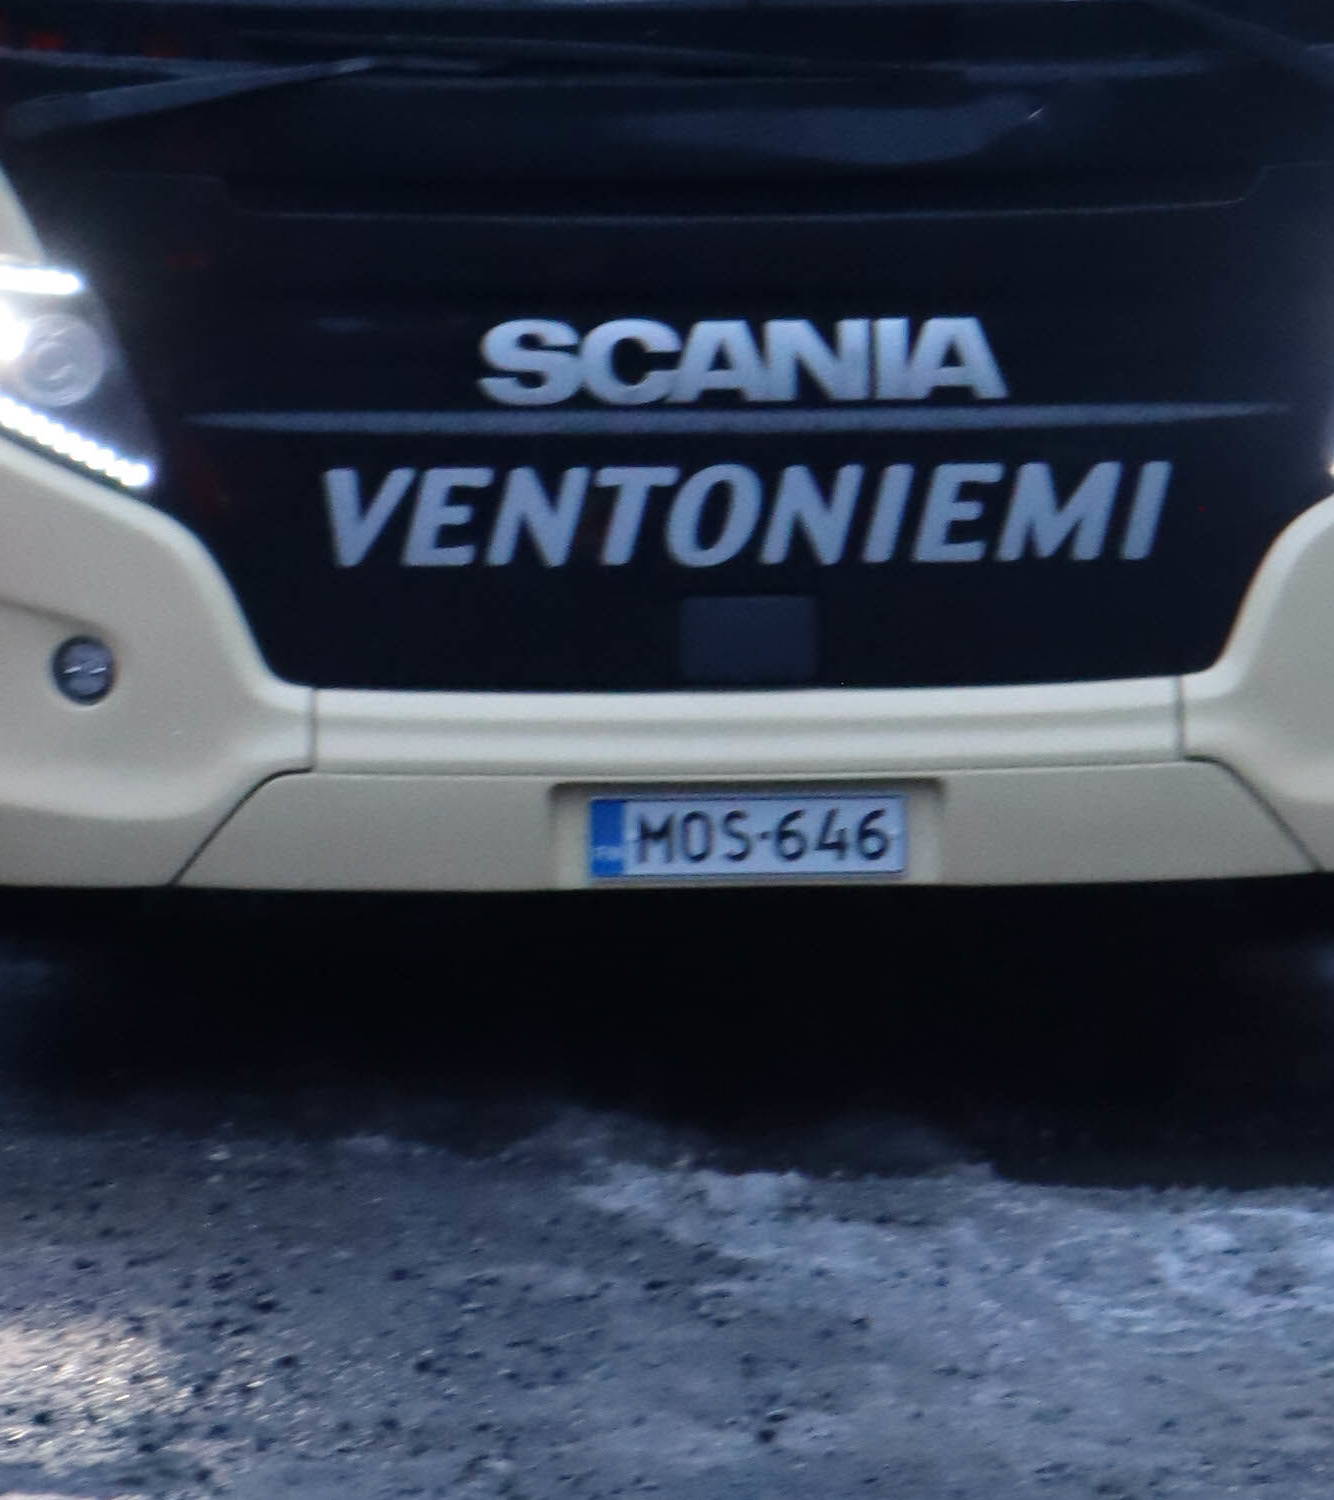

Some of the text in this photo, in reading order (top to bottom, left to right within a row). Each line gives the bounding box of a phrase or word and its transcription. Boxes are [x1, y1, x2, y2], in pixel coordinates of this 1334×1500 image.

[479, 316, 1008, 406] SCANIA
[323, 460, 1173, 568] VENTONIEMI
[635, 808, 890, 863] MOS-646
